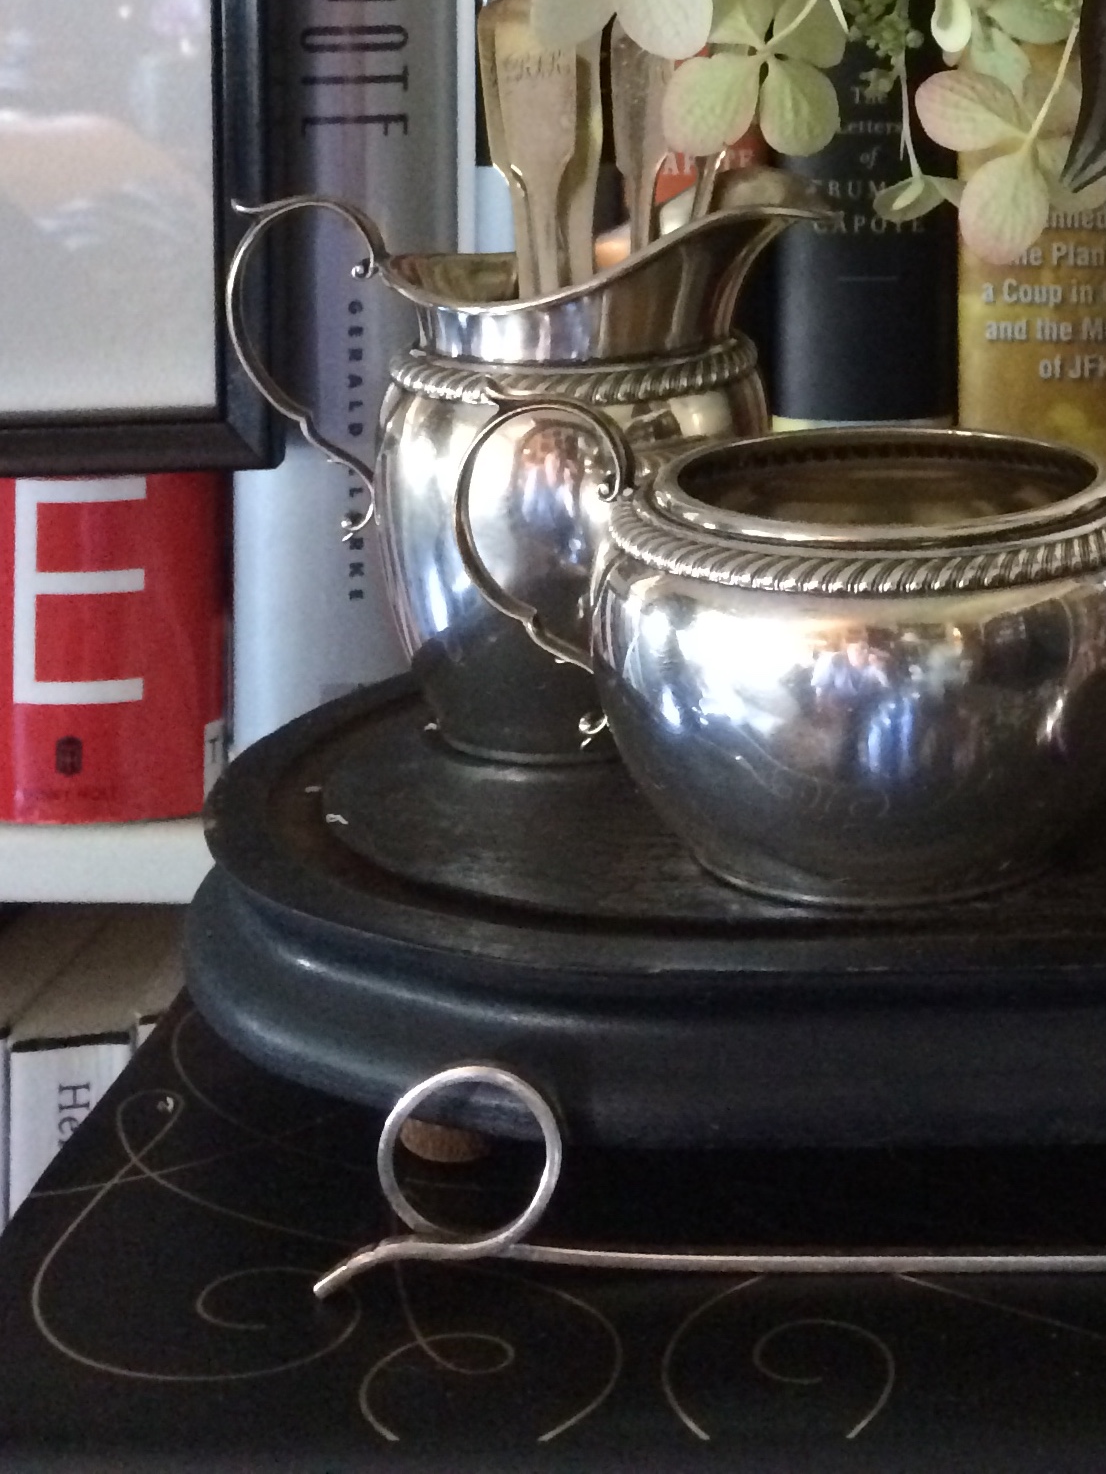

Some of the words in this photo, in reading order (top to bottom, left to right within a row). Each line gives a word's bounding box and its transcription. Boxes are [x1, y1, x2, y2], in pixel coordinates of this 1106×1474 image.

[1053, 241, 1105, 266] Plan
[982, 282, 995, 303] a
[1003, 278, 1062, 307] Coup
[1070, 279, 1094, 303] in
[985, 318, 1028, 341] and
[1036, 317, 1073, 341] the
[348, 300, 364, 437] GERALD
[1038, 354, 1062, 378] of
[13, 476, 147, 706] E
